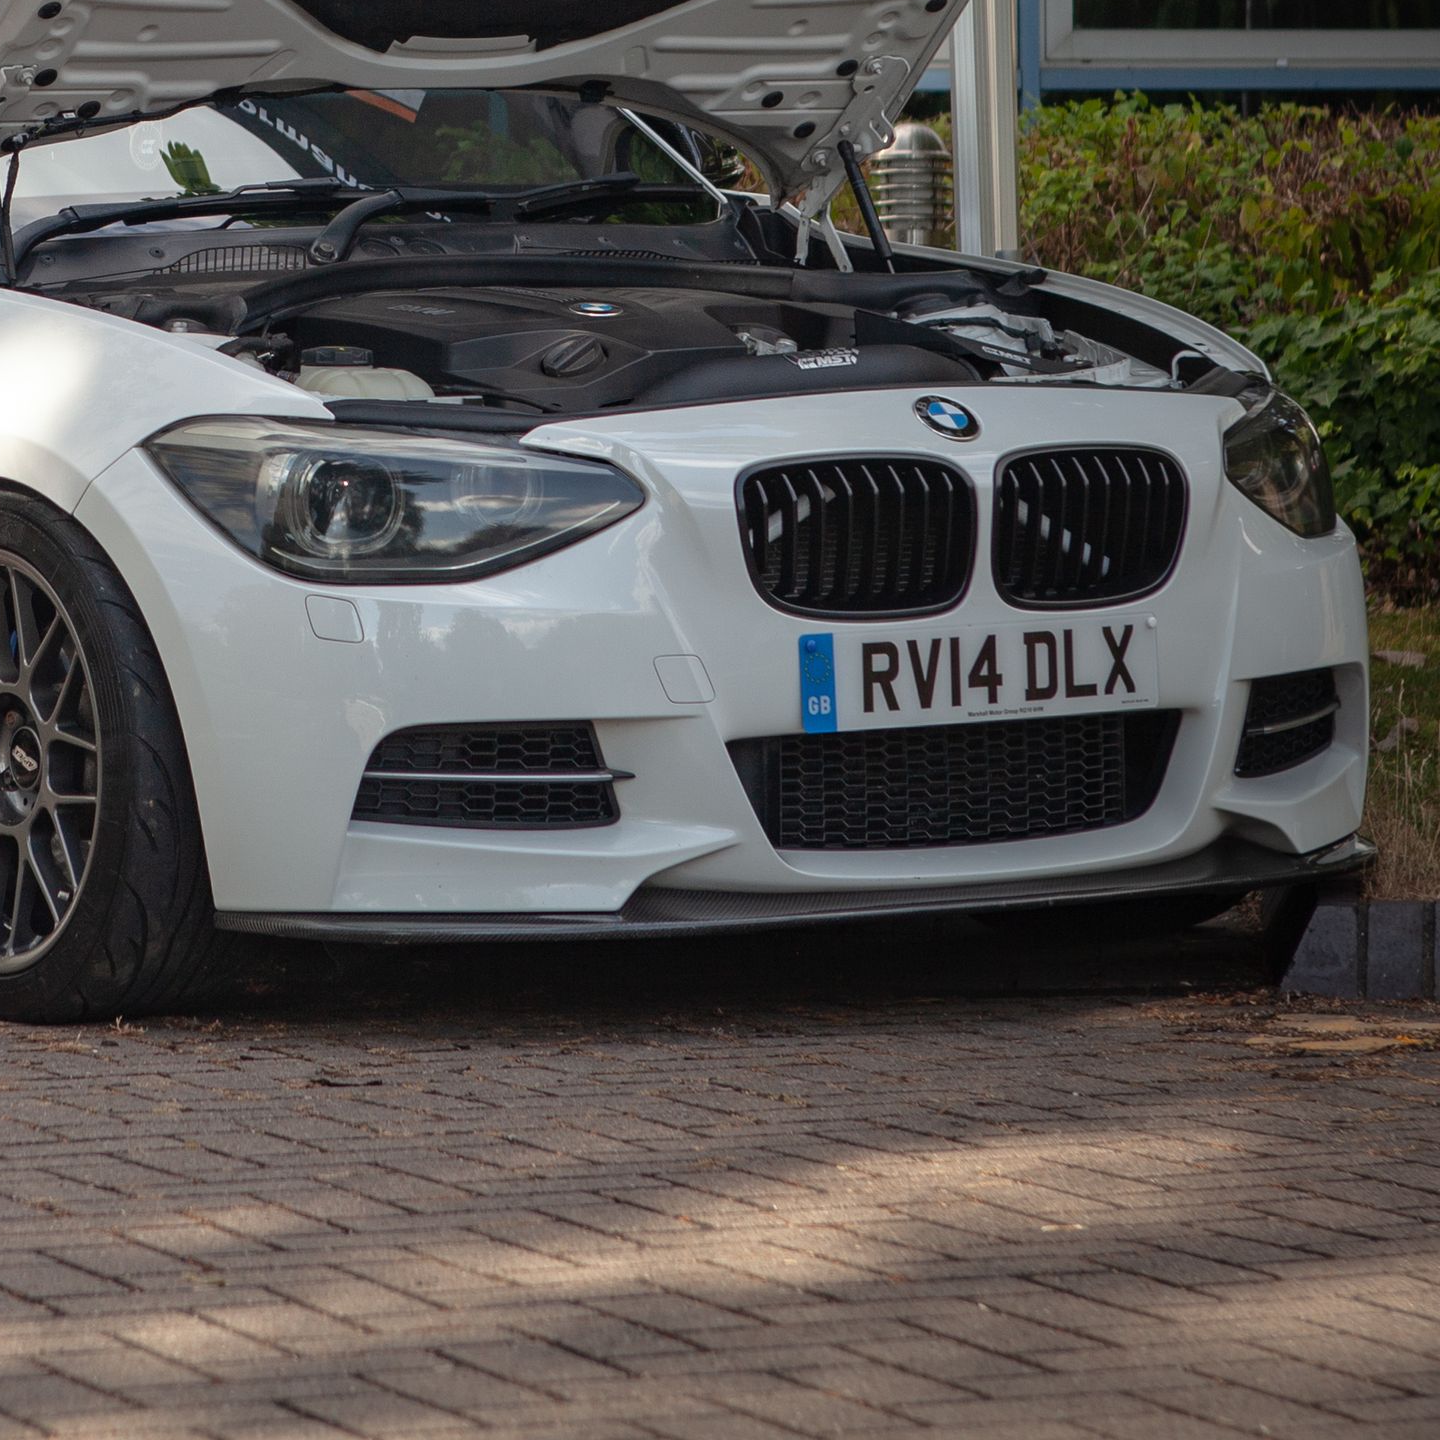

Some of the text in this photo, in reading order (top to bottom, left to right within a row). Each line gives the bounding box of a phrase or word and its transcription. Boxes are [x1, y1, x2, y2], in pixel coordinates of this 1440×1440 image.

[861, 624, 1136, 713] RV14 DLX
[808, 696, 831, 715] GB
